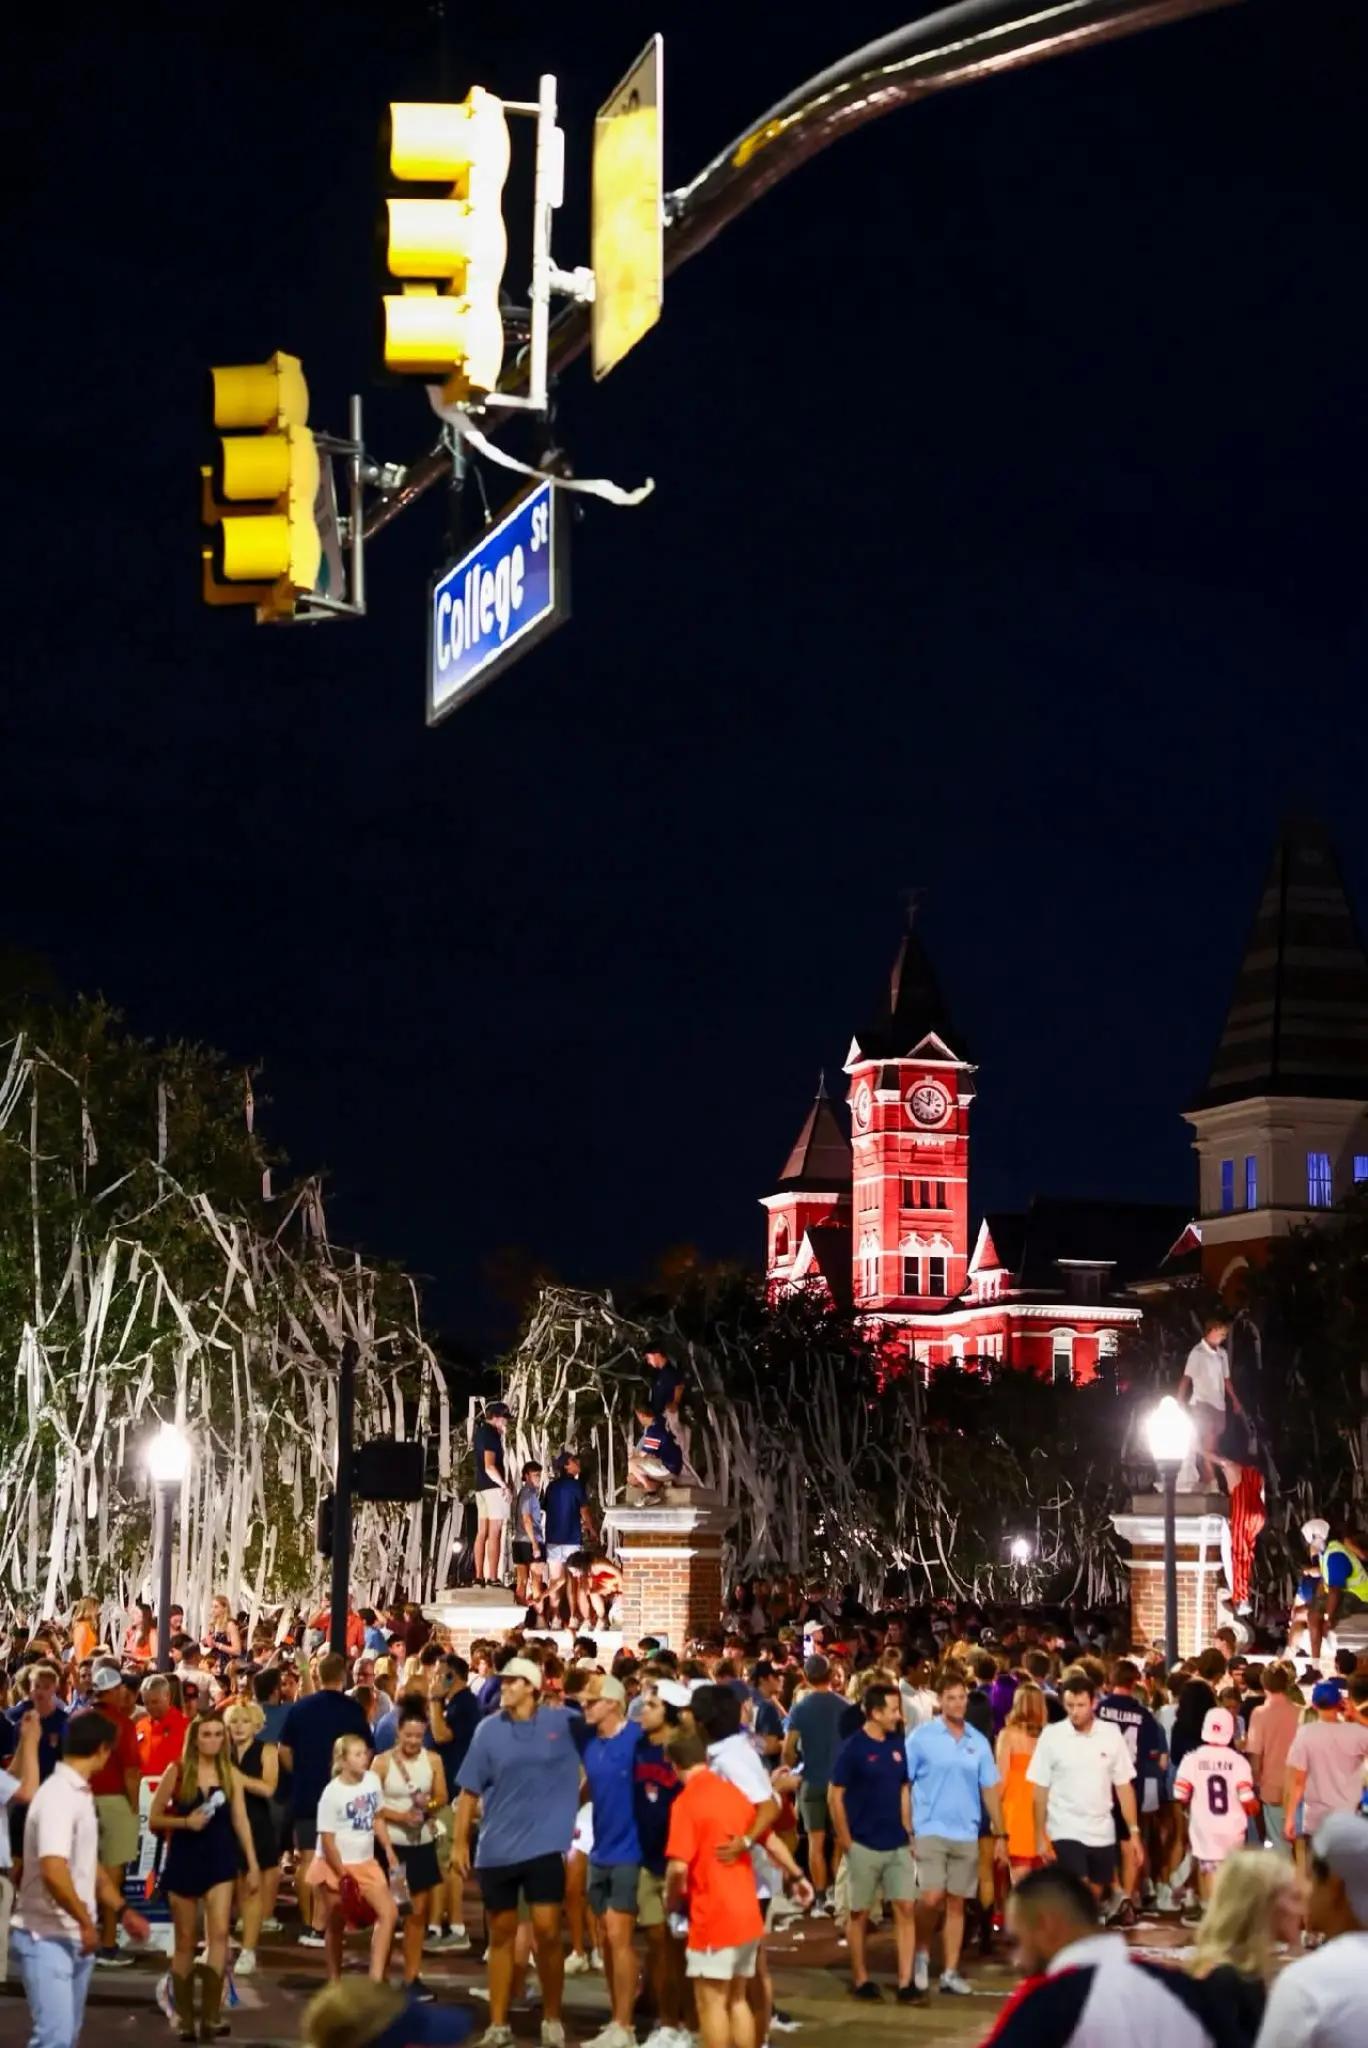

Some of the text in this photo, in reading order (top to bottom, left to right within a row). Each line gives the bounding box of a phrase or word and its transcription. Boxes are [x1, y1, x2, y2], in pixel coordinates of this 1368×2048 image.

[437, 501, 548, 671] College St
[1207, 1773, 1229, 1816] 8
